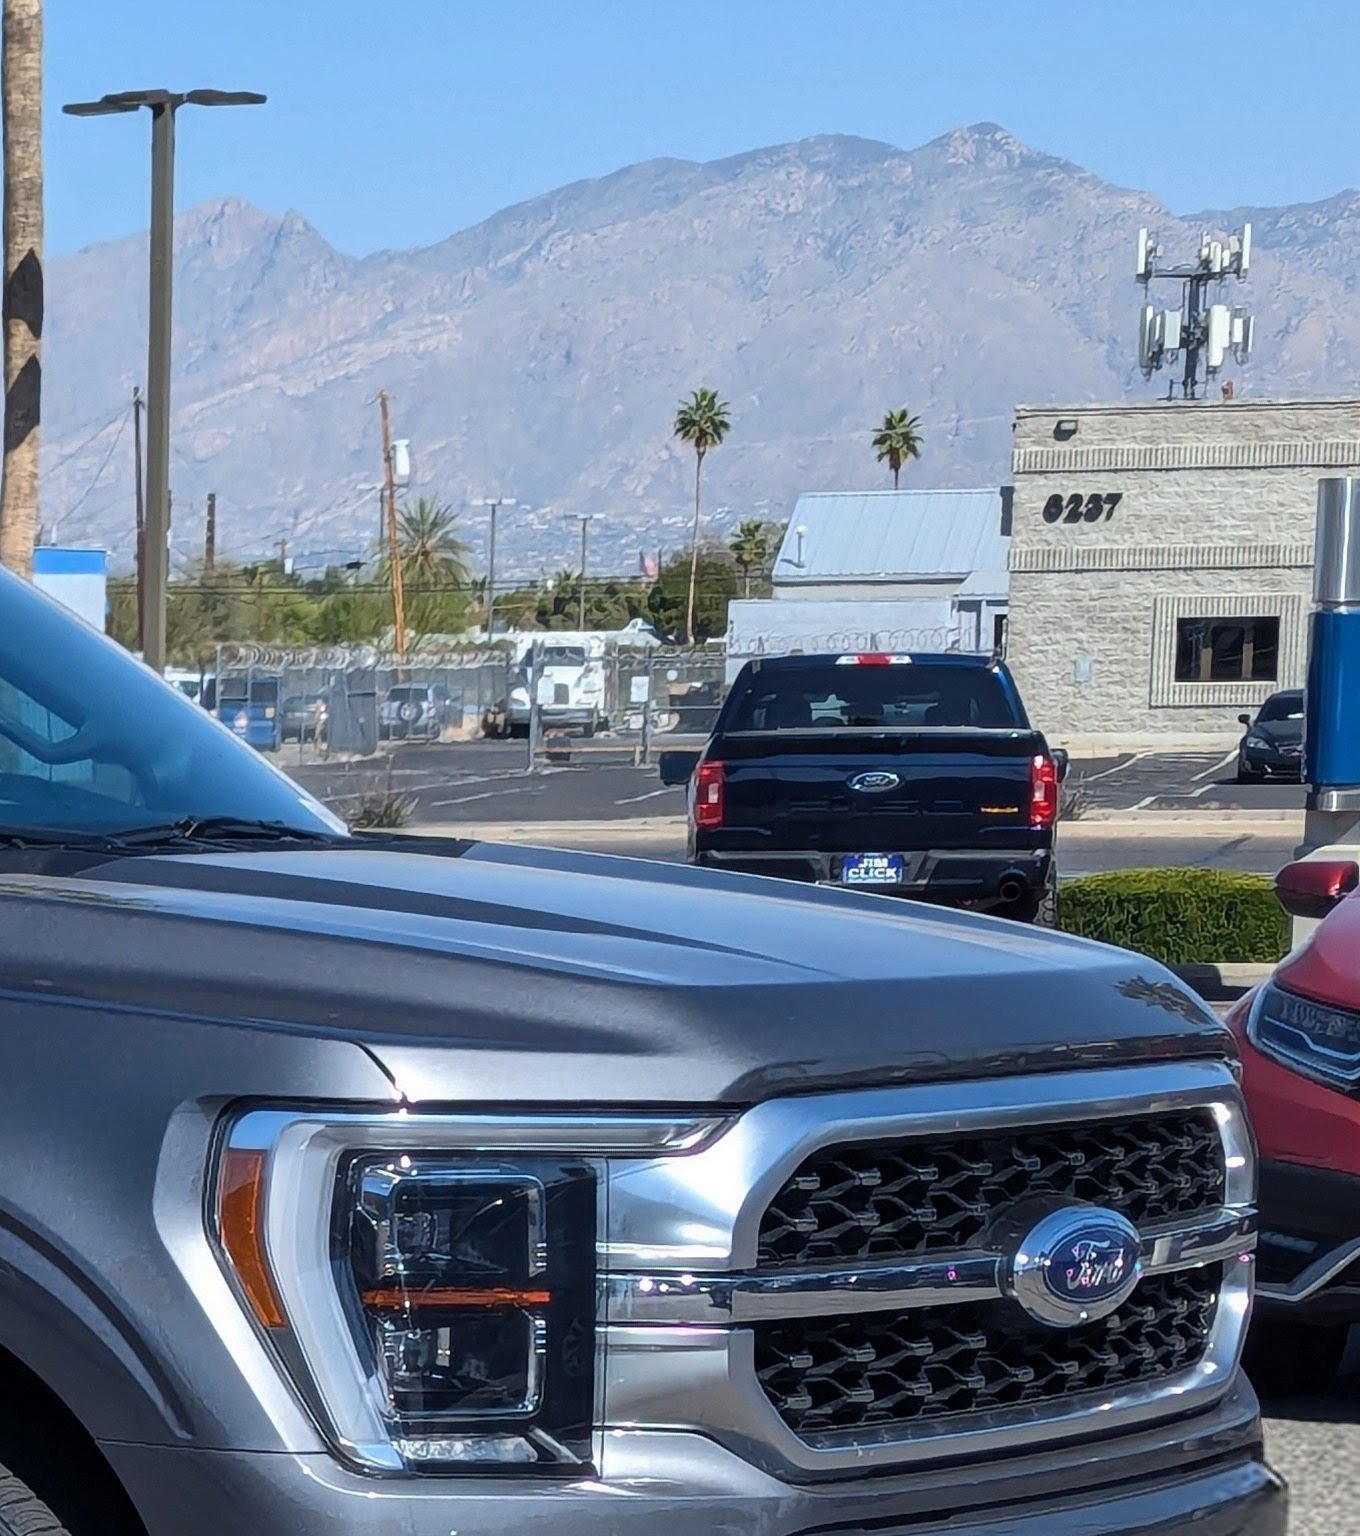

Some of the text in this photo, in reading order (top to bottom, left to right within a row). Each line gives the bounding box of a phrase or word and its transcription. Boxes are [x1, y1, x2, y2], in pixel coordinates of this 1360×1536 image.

[857, 858, 888, 868] JIM
[848, 868, 897, 878] CLICK
[1066, 1239, 1124, 1290] Ford
